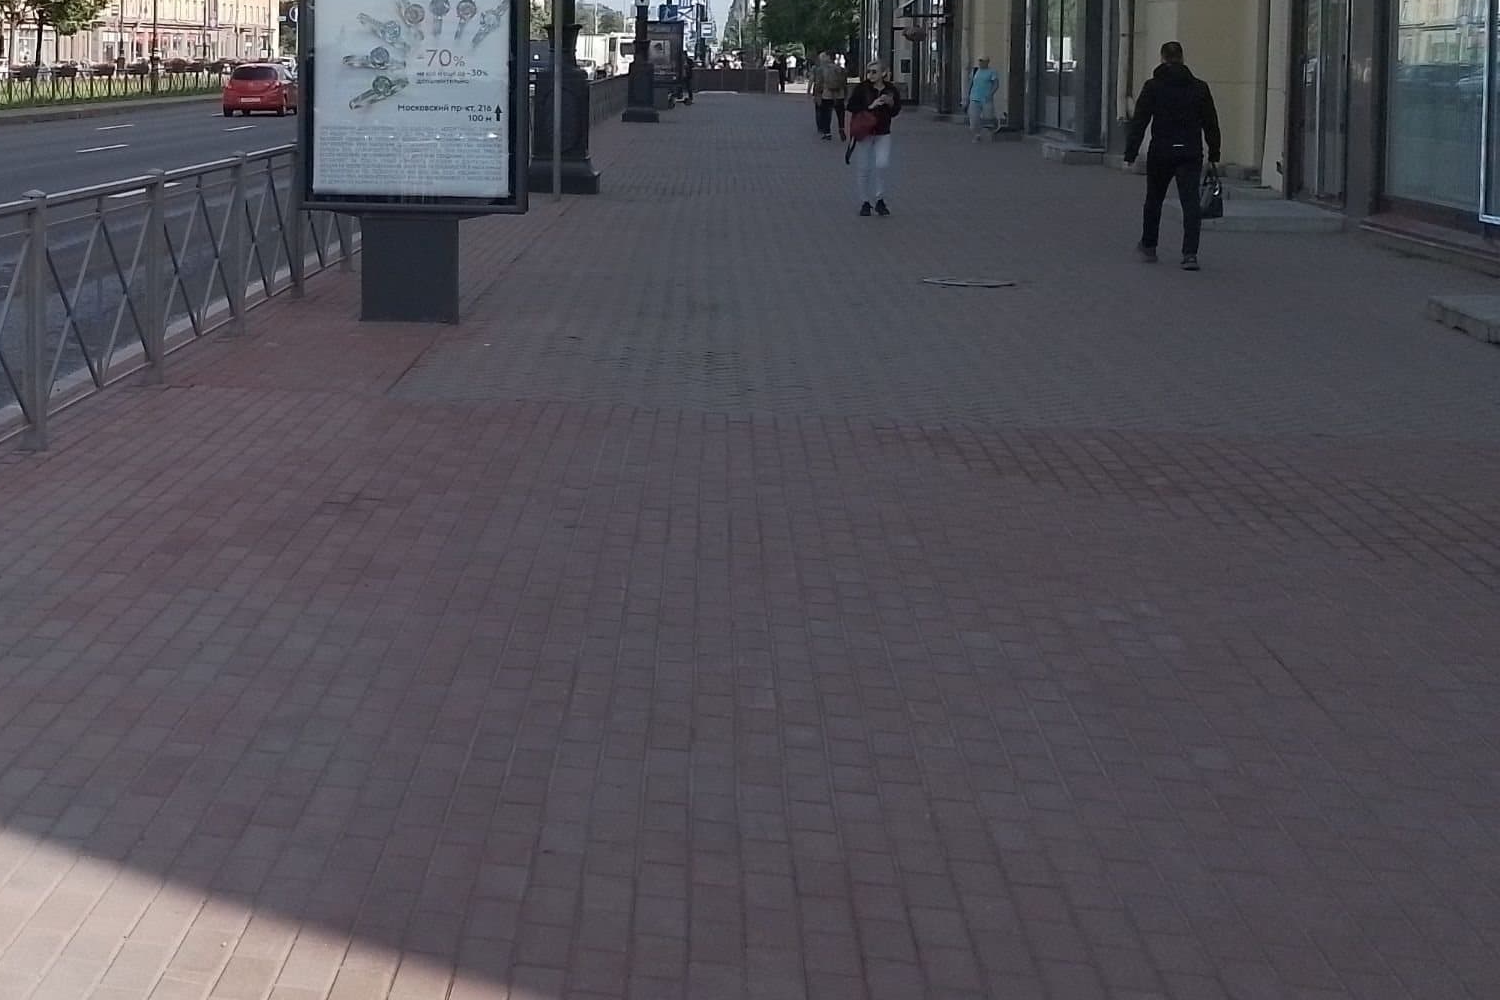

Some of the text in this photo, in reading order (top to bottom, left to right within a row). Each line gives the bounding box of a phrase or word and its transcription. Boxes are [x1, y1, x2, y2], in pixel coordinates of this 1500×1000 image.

[417, 49, 466, 67] -70%
[397, 104, 449, 112] Московский
[468, 114, 484, 122] 100
